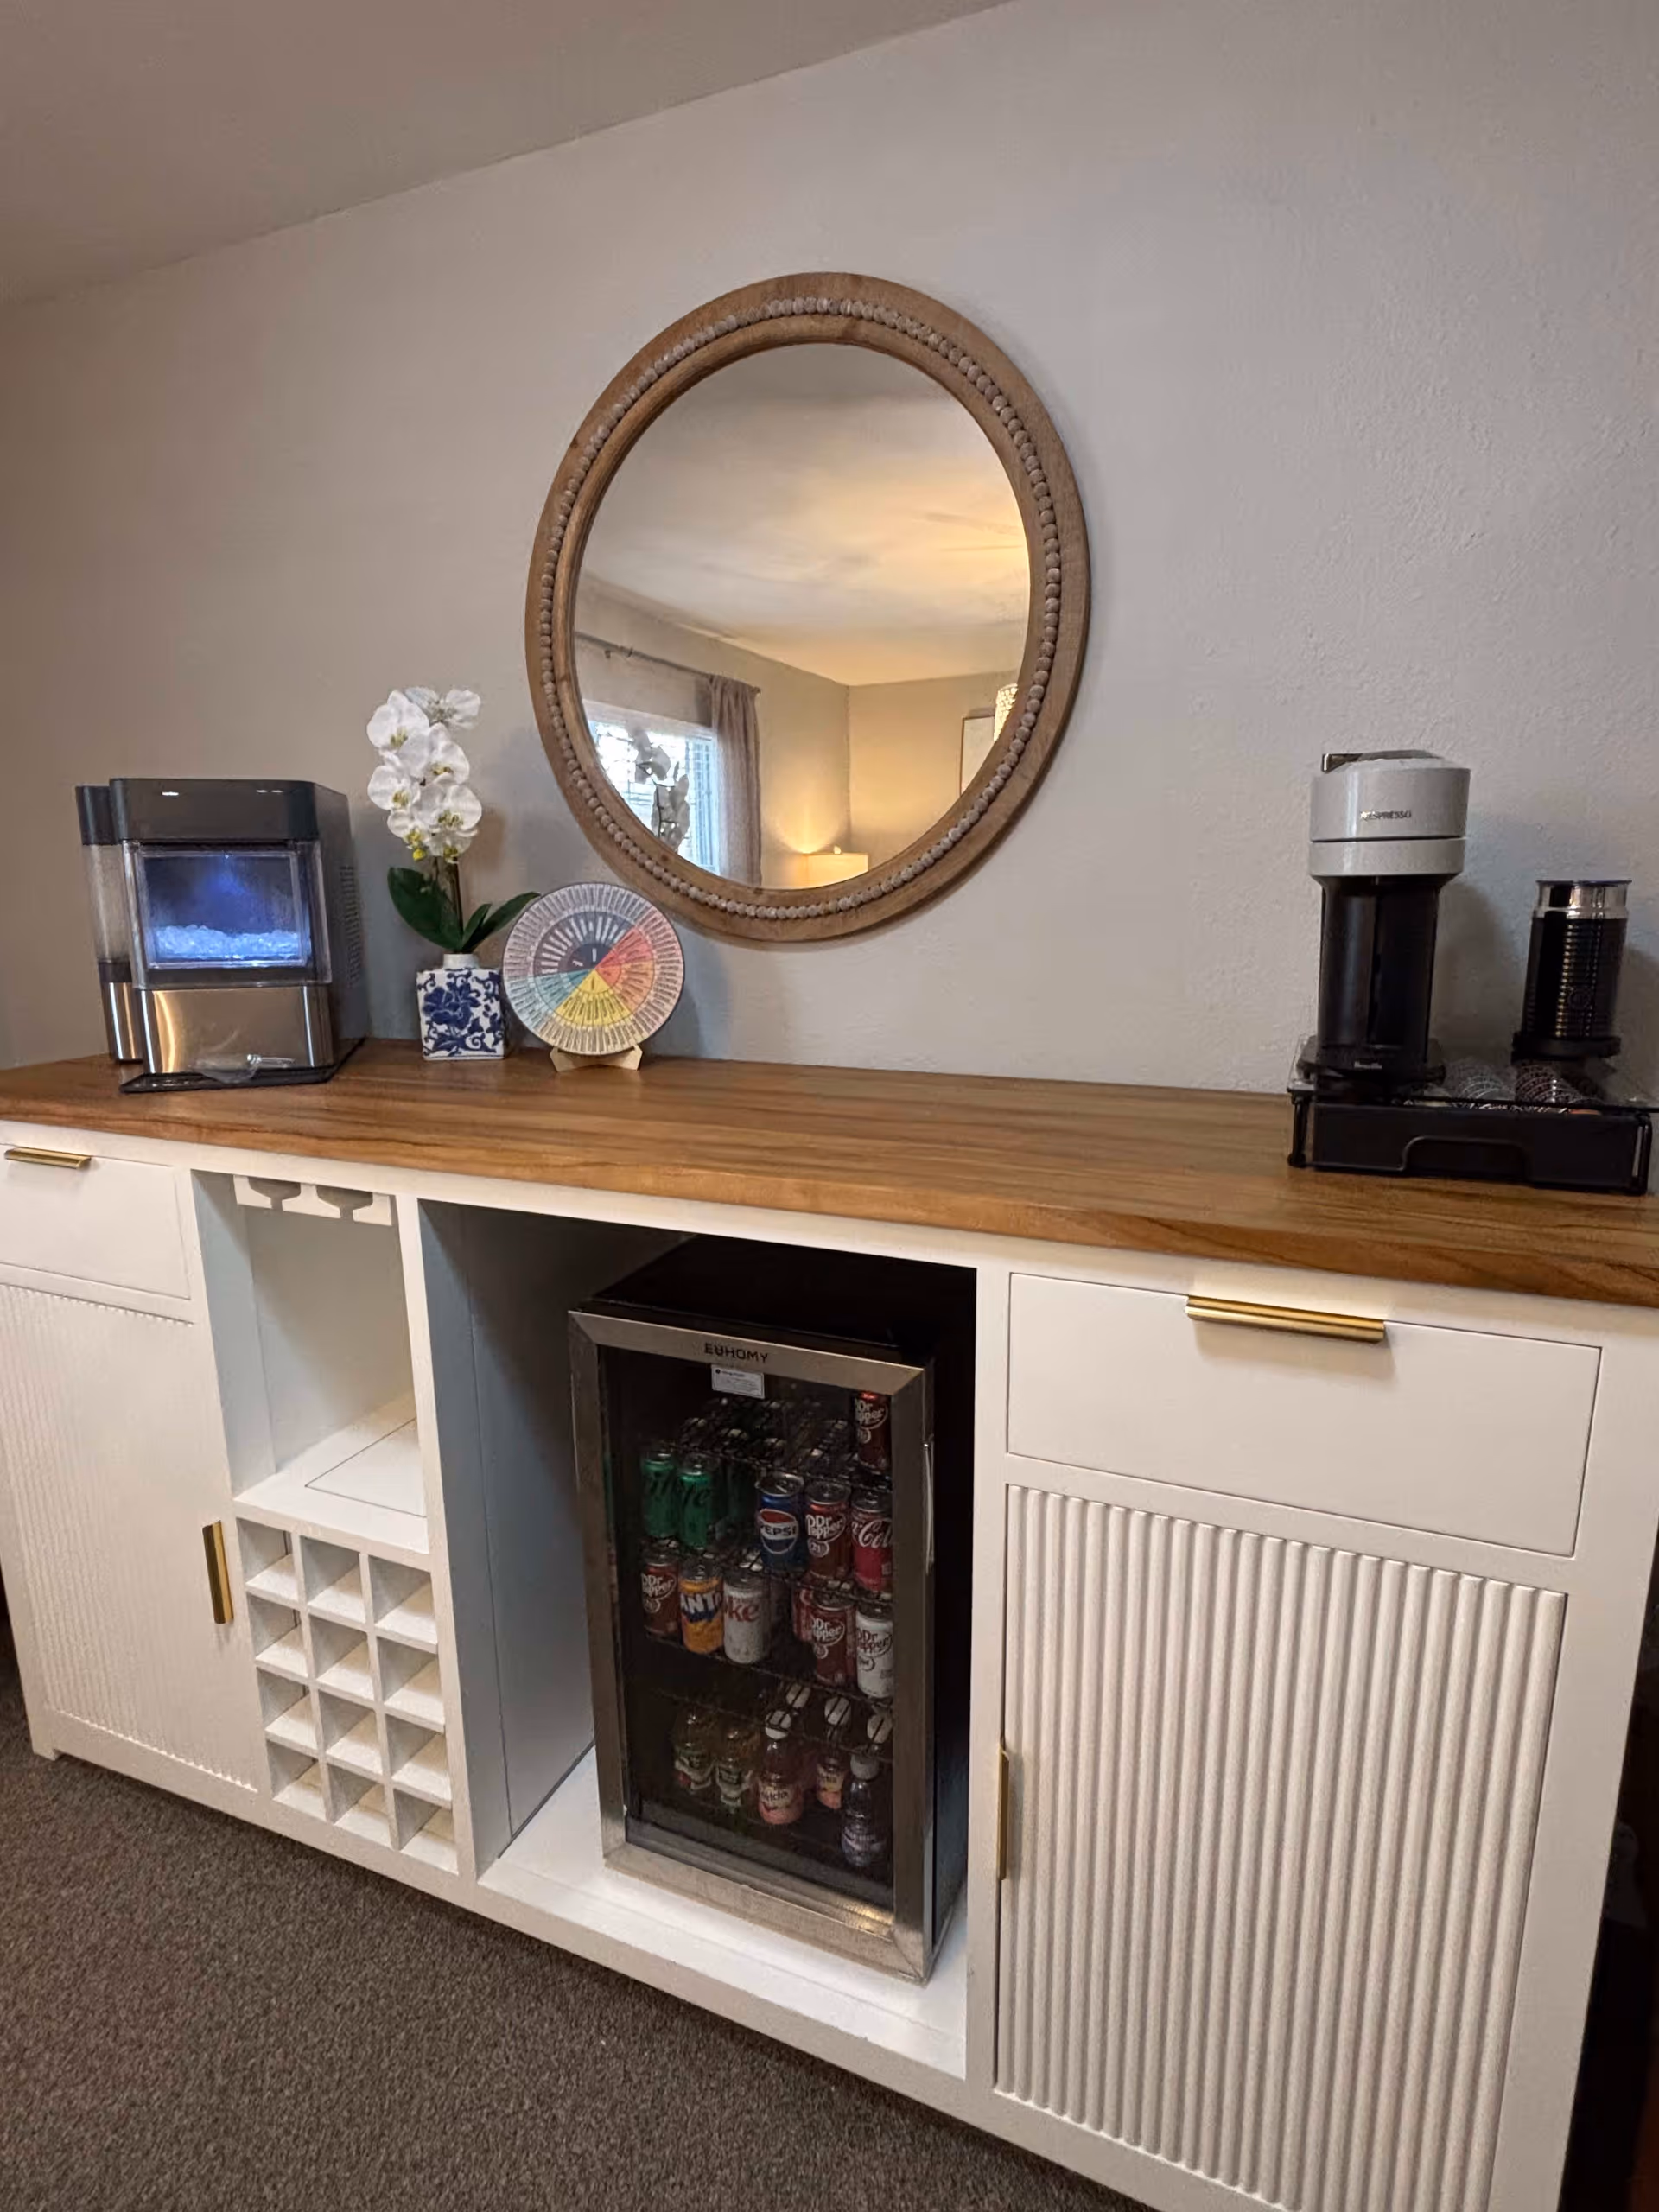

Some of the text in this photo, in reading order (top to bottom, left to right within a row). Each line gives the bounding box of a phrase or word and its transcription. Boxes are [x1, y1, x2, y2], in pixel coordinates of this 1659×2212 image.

[704, 1342, 768, 1363] EUHOMY
[815, 1515, 832, 1528] Dr
[760, 1525, 797, 1536] EPSI
[648, 1575, 664, 1586] Dr
[680, 1592, 722, 1614] ANT
